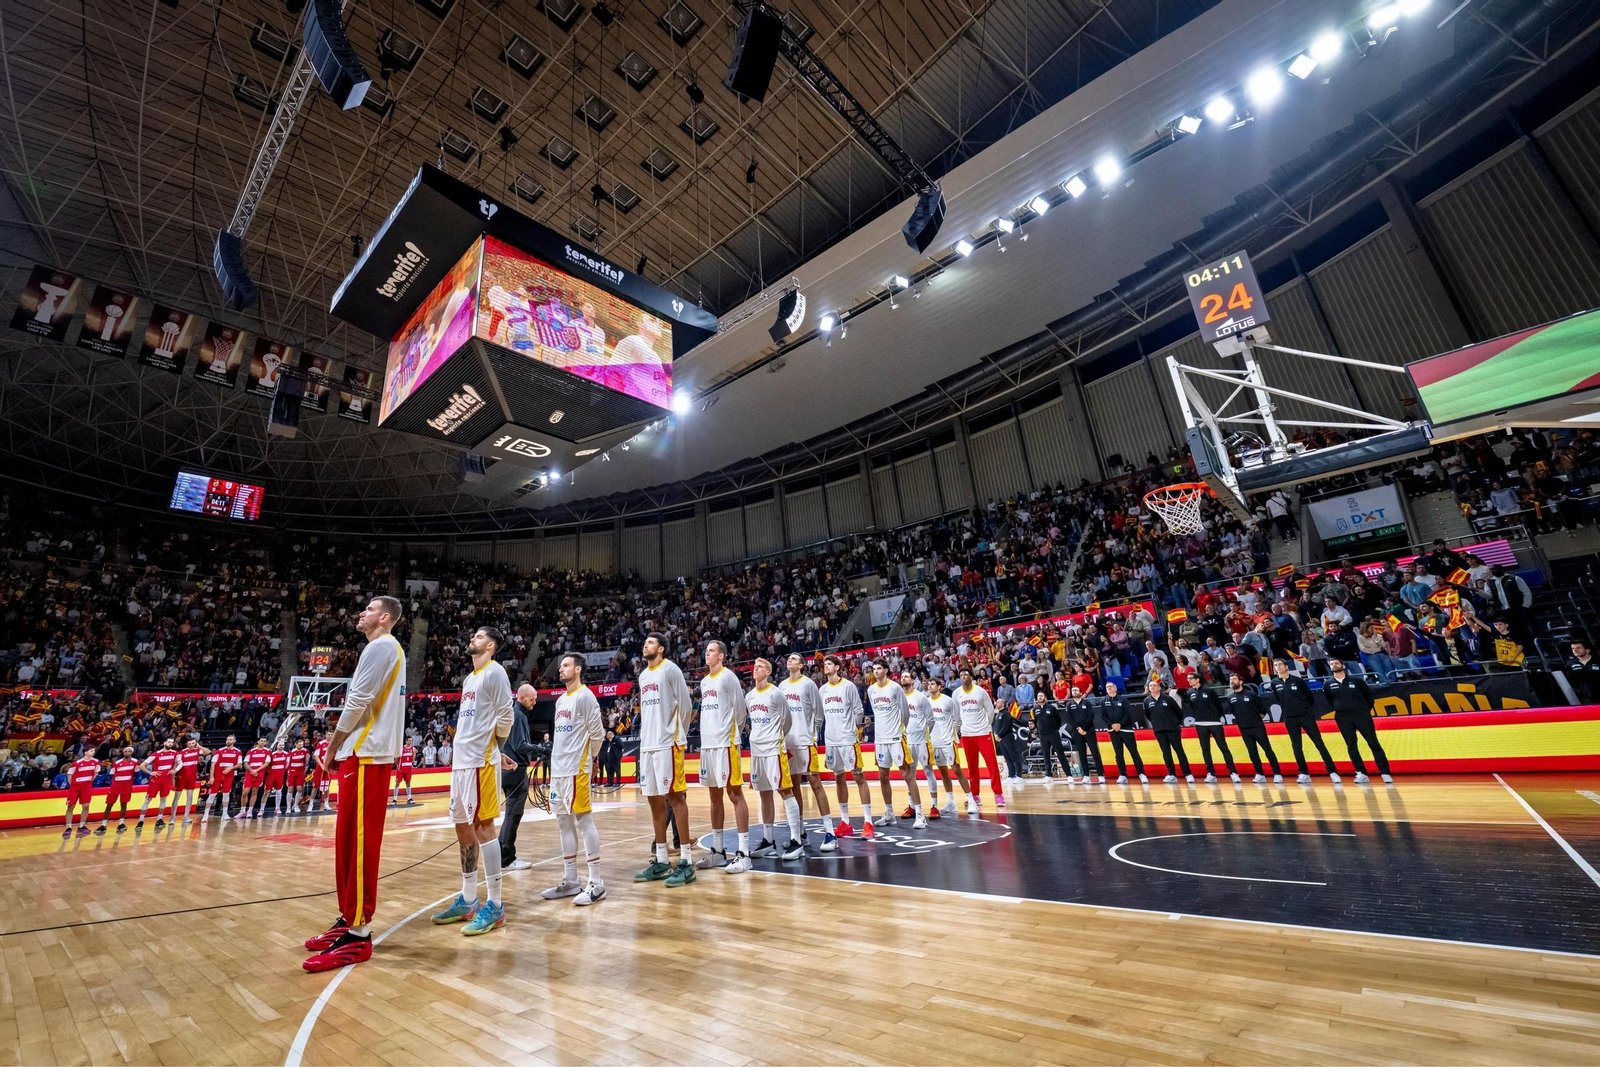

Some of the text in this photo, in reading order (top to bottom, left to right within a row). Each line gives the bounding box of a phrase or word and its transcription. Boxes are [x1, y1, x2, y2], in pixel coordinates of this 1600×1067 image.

[1188, 256, 1243, 287] 04:11
[1200, 282, 1254, 324] 24
[1215, 318, 1256, 338] LOTUS
[1350, 508, 1385, 525] DXT
[1355, 518, 1391, 530] TENERIFE
[1379, 527, 1395, 535] EXIT
[315, 655, 329, 664] 24
[825, 695, 843, 705] ESPAÑA
[873, 696, 890, 705] ESPAÑA
[750, 704, 768, 713] ESPAÑA
